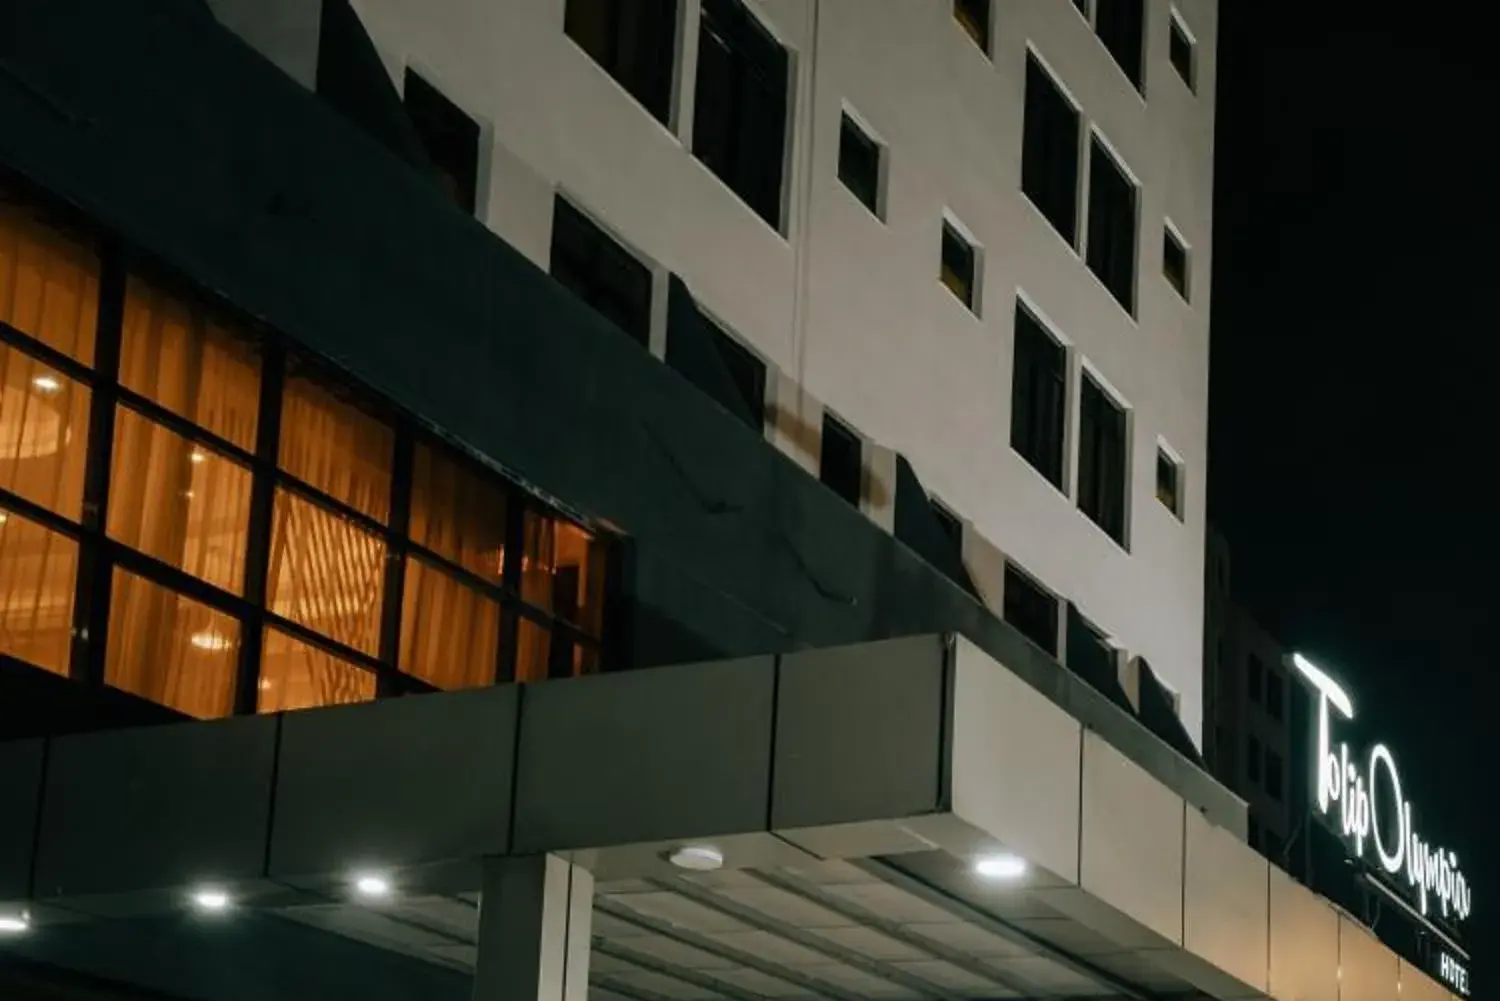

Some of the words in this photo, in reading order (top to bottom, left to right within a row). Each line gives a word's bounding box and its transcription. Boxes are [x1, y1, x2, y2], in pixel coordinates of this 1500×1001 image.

[1293, 651, 1370, 857] Tolip
[1369, 743, 1471, 920] Olympia
[1440, 951, 1471, 995] HOTEL
